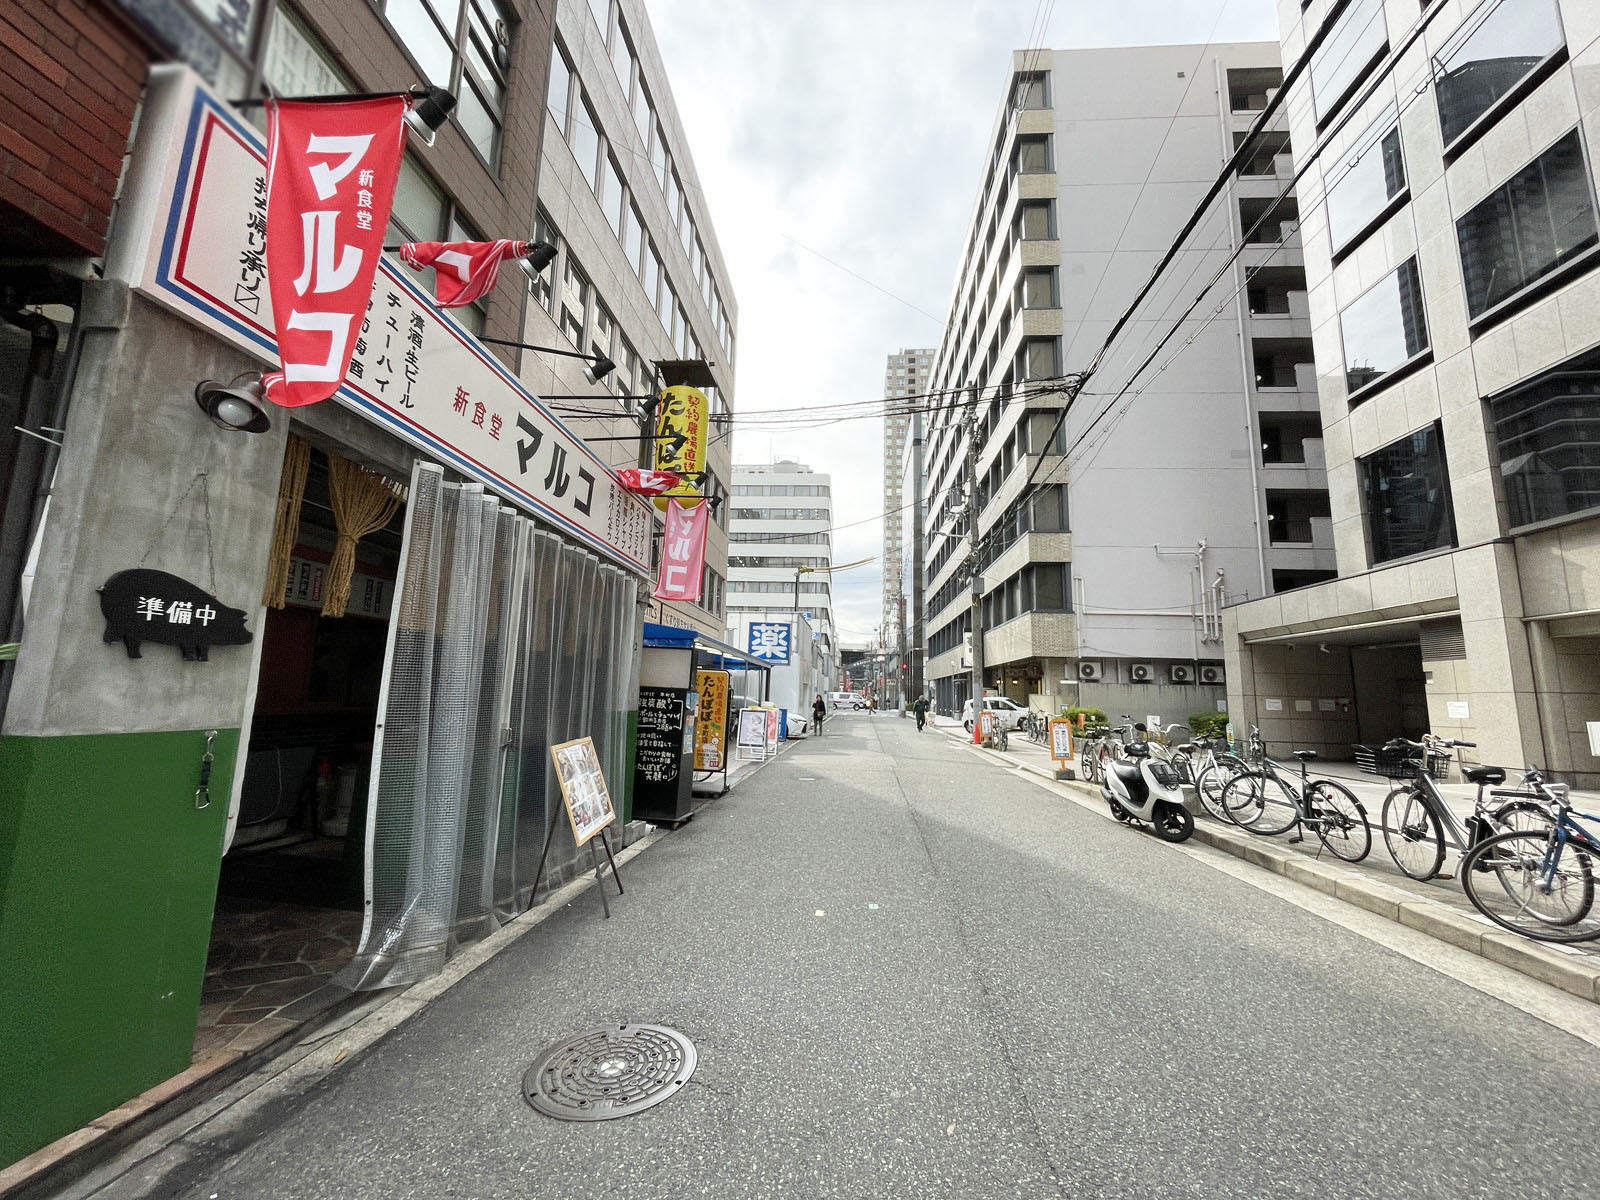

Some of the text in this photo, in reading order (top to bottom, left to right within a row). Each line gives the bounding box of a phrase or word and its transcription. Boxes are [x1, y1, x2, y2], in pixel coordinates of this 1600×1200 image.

[356, 168, 374, 231] 新食堂
[283, 133, 376, 386] マルコ
[376, 291, 402, 393] チューハイ
[453, 385, 503, 441] 新食堂
[516, 411, 596, 518] マルコ
[136, 596, 216, 627] 準備中
[751, 623, 788, 659] 薬
